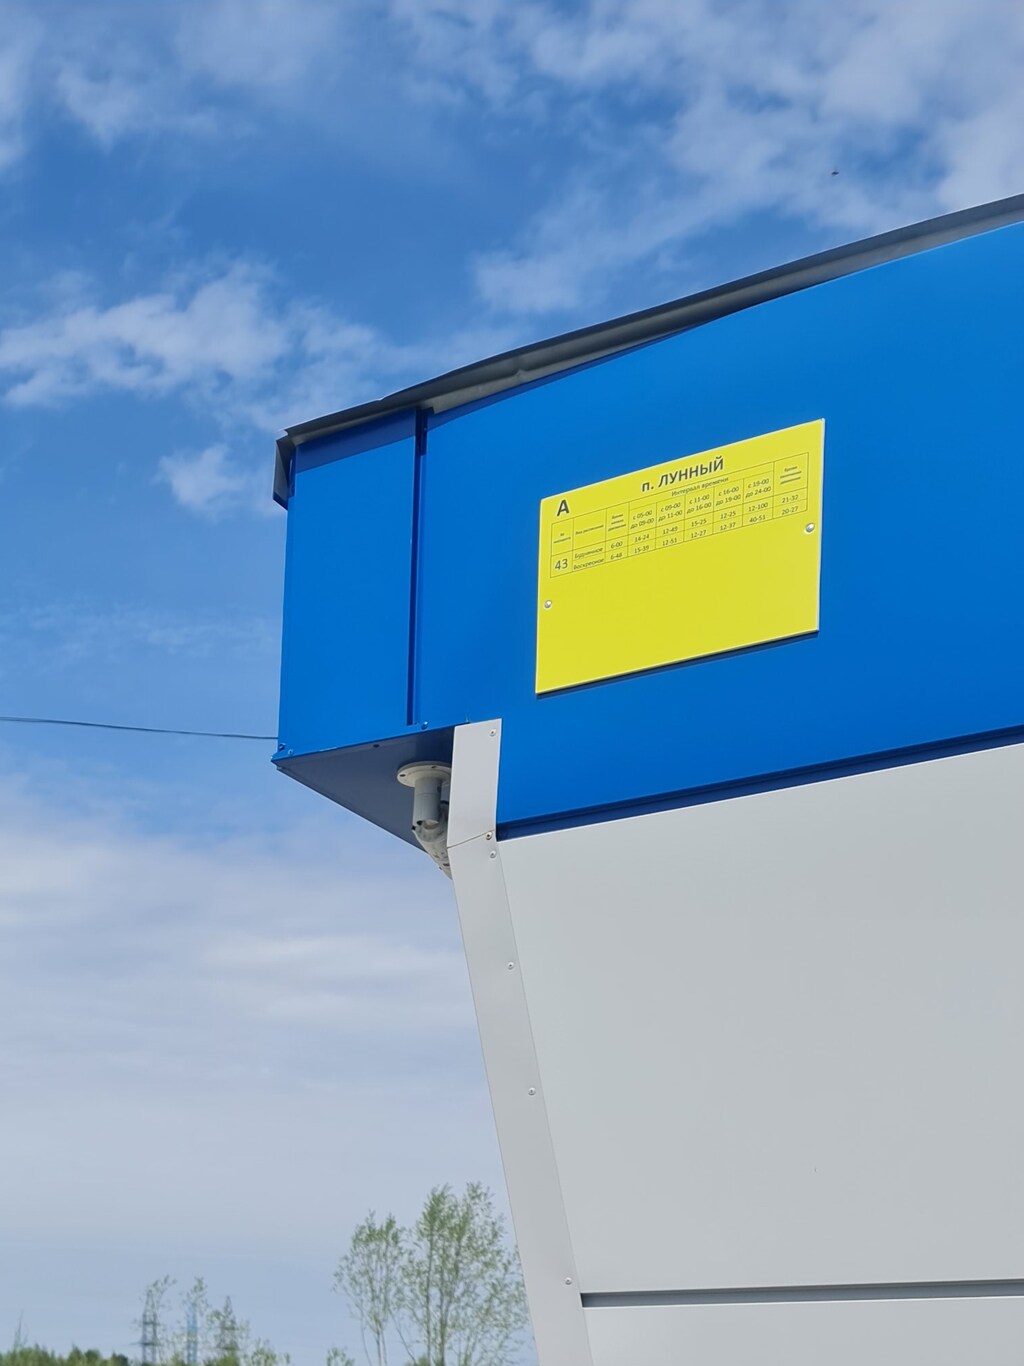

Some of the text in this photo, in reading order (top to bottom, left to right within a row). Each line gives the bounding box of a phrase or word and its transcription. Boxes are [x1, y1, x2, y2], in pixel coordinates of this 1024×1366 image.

[642, 455, 723, 492] п. ЛУННЫЙ
[557, 499, 570, 517] А
[554, 558, 568, 571] 43
